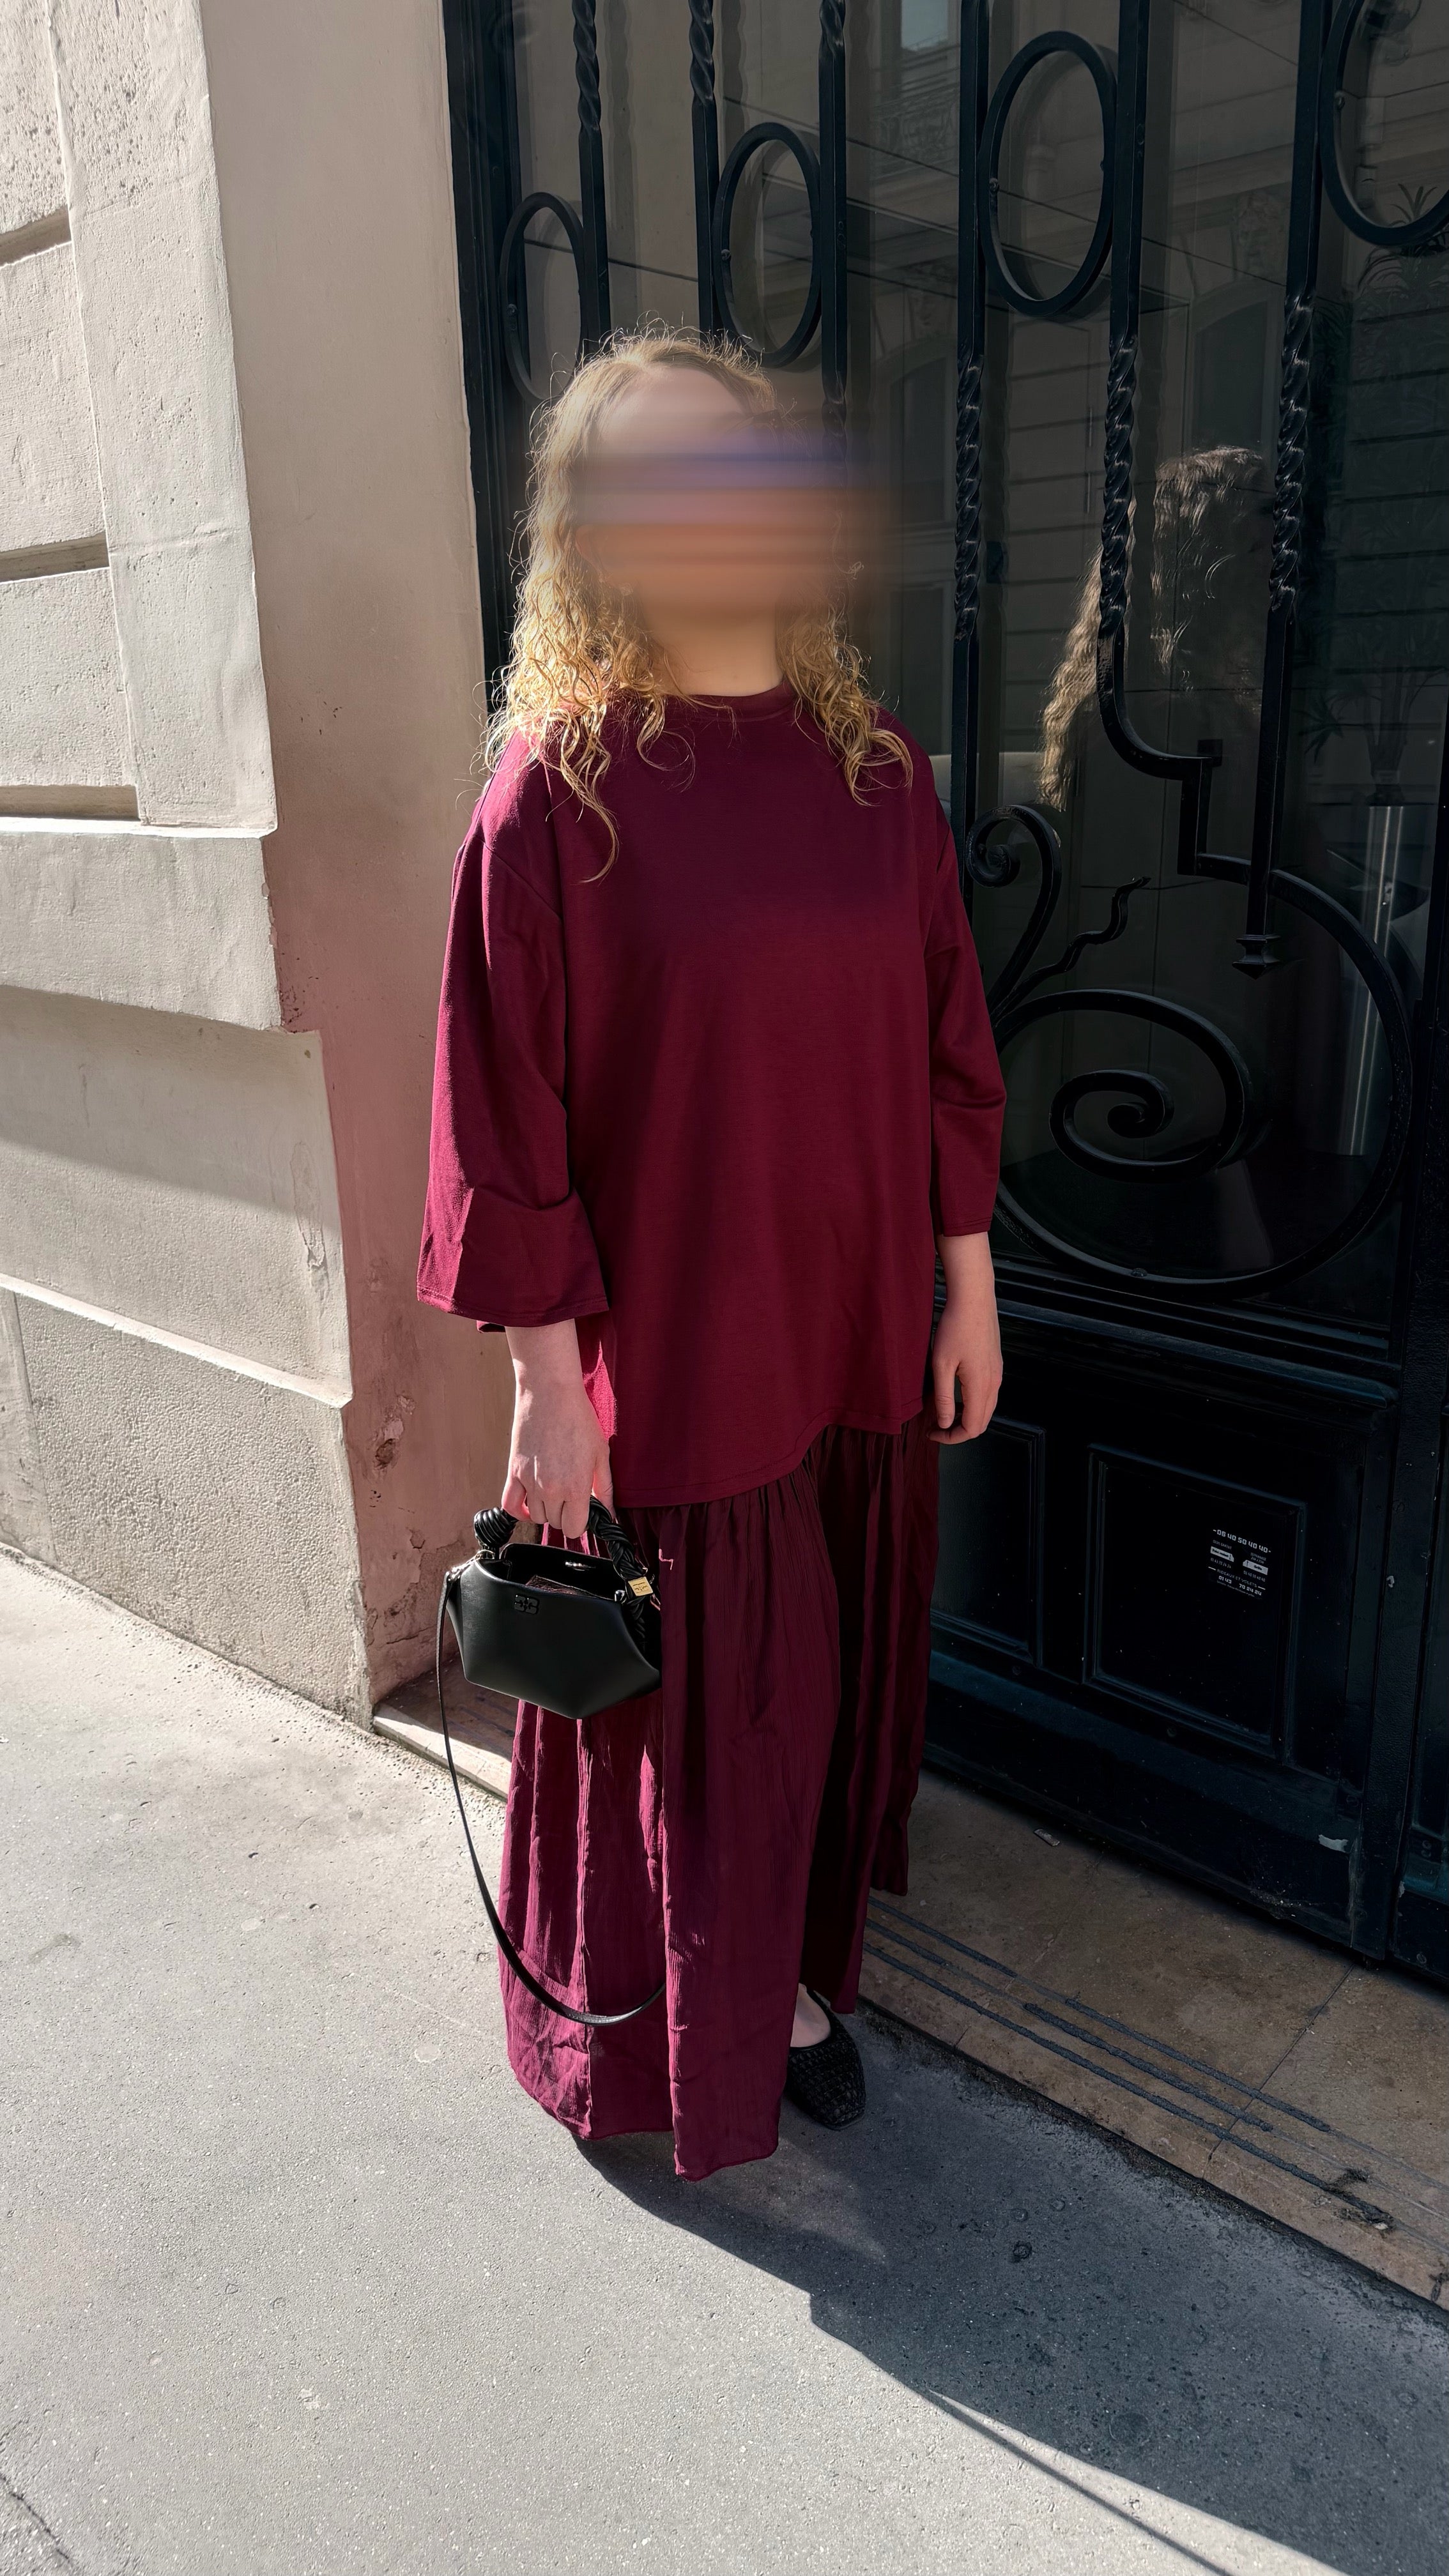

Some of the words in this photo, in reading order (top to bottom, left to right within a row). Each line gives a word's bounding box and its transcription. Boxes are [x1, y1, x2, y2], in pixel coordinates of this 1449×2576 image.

[1227, 1533, 1237, 1541] 40
[1238, 1537, 1247, 1545] 50
[1248, 1541, 1257, 1549] 40
[1259, 1544, 1268, 1553] 40
